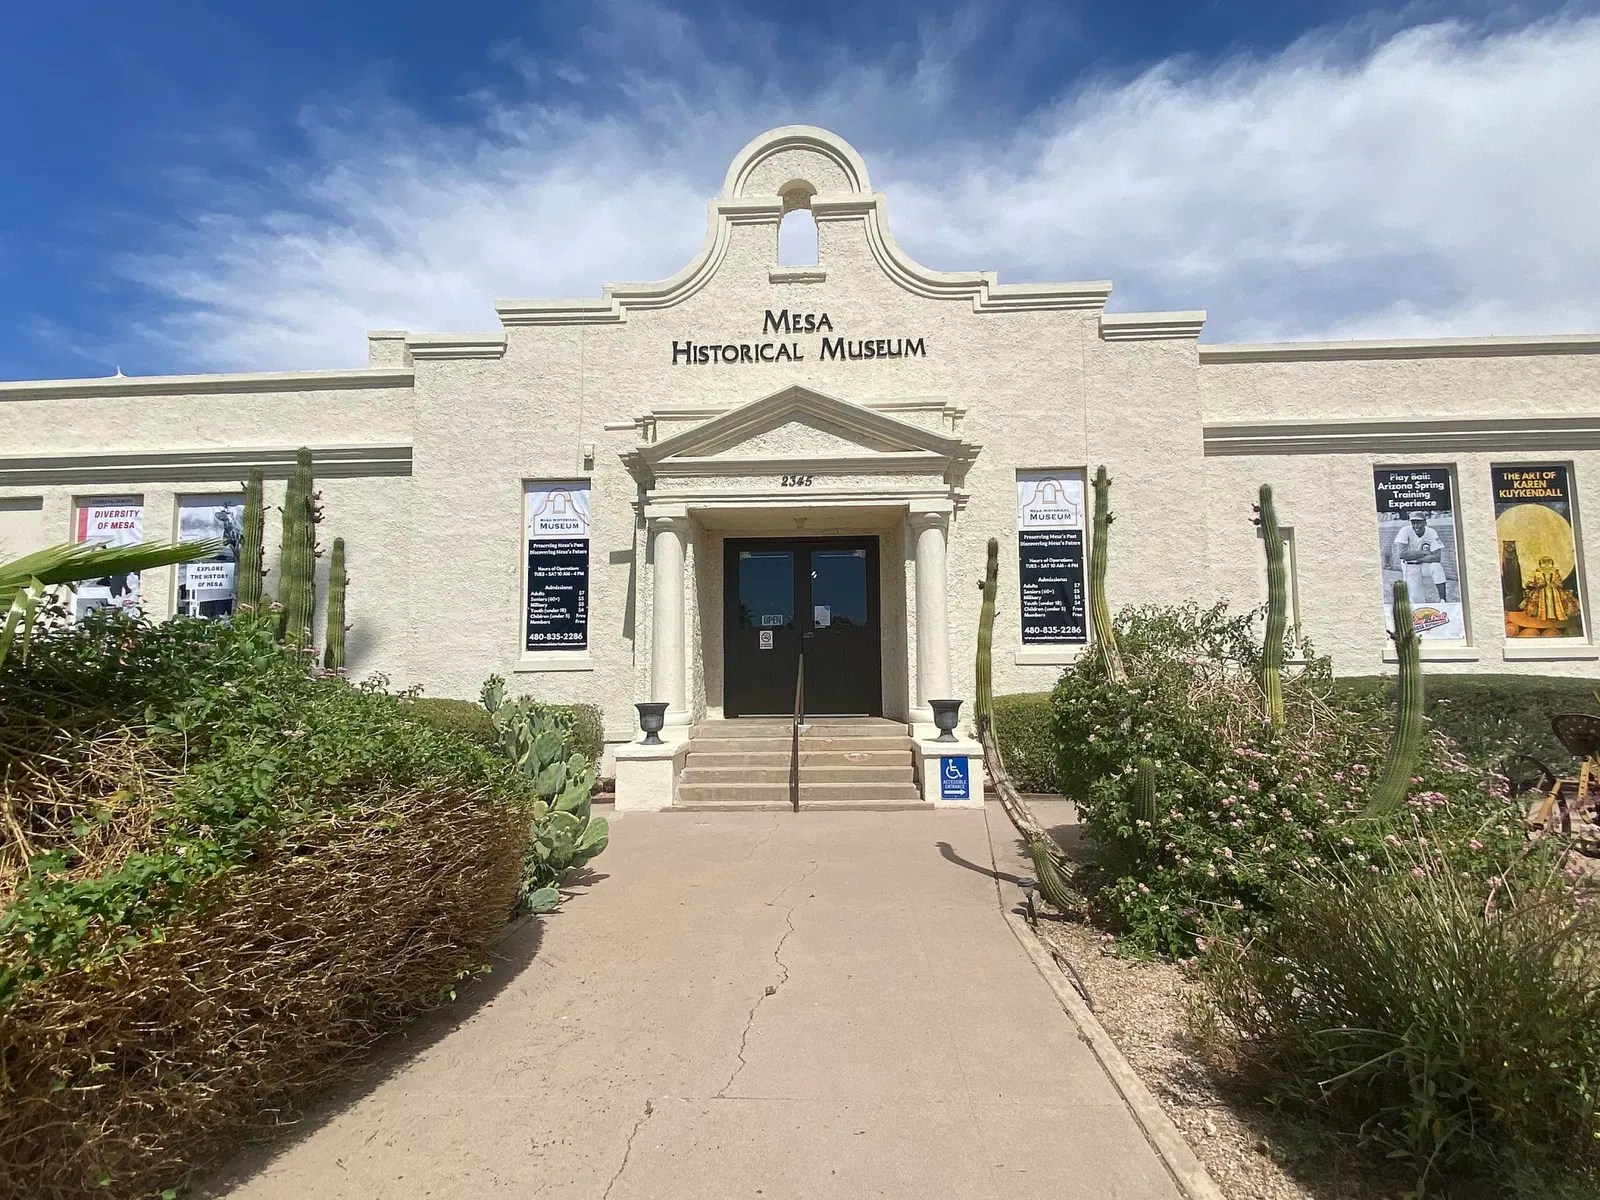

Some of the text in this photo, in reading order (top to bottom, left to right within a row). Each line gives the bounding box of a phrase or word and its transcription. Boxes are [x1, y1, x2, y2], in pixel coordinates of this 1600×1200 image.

[762, 309, 834, 334] MESA
[672, 337, 927, 365] HISTORICAL MUSEUM
[1390, 473, 1409, 482] Play
[1503, 472, 1520, 480] THE
[1522, 472, 1540, 480] ART
[781, 476, 813, 487] 2345
[1378, 480, 1444, 490] Arizona Spring
[1514, 480, 1546, 488] KAREN
[1392, 490, 1430, 500] Training
[1499, 488, 1563, 498] KUYKENDALL
[1388, 499, 1436, 509] Experience
[94, 510, 140, 518] DIVERSITY
[98, 522, 108, 530] OF
[764, 616, 782, 624] OPEN
